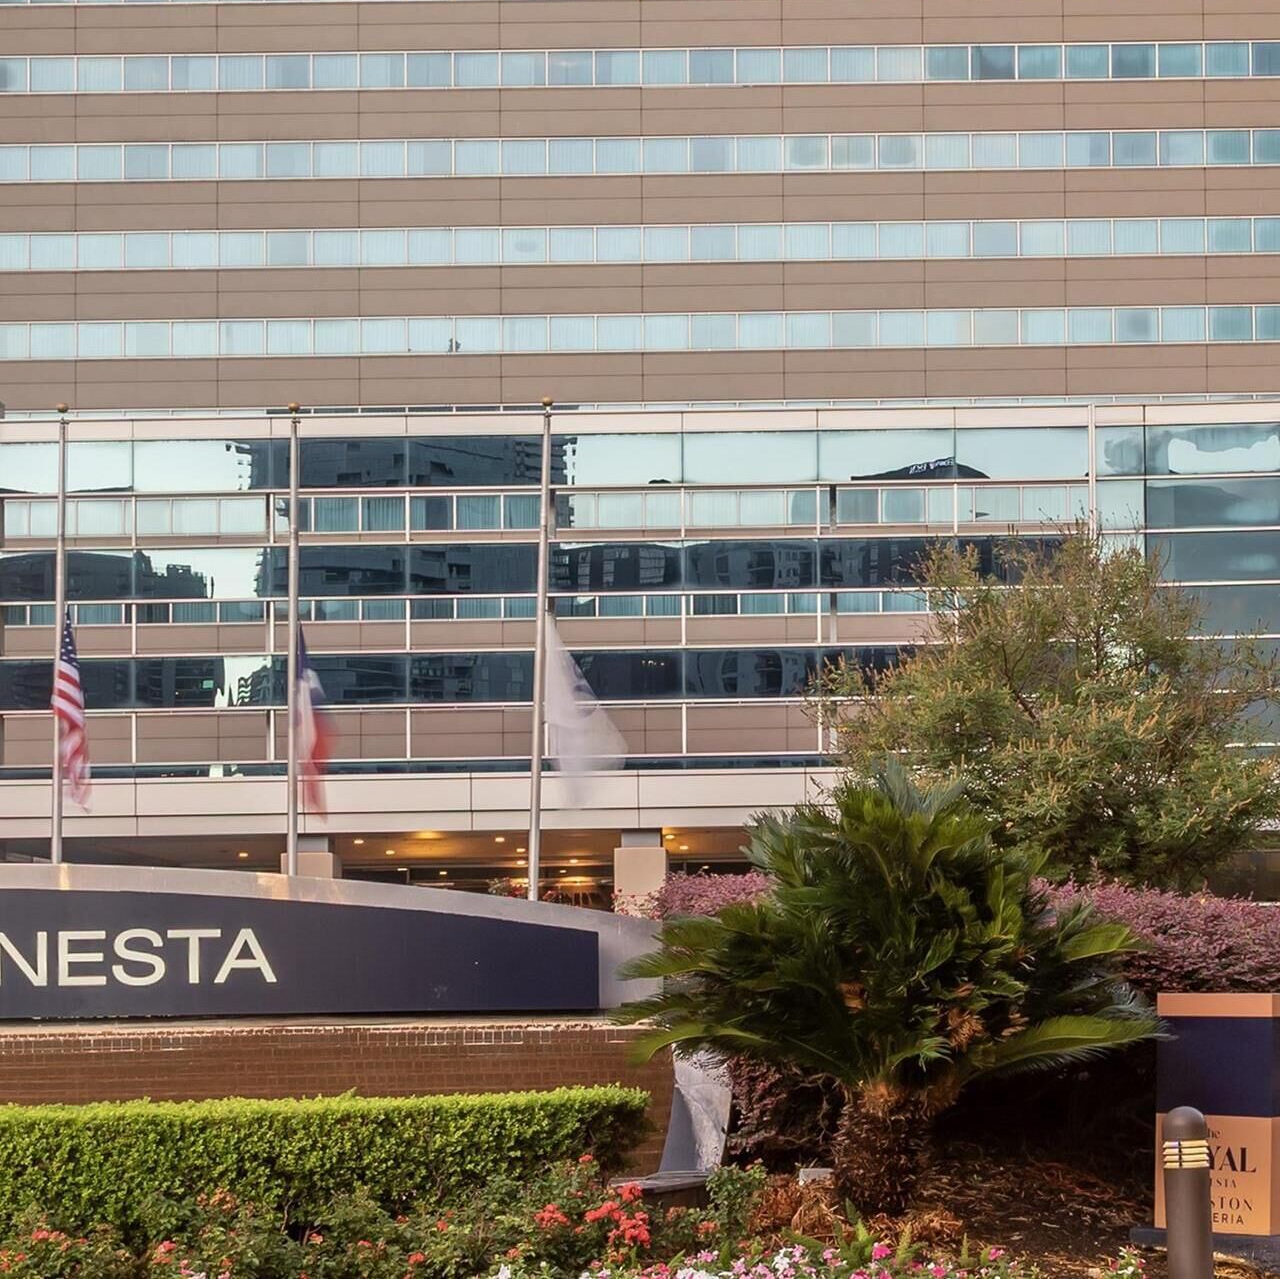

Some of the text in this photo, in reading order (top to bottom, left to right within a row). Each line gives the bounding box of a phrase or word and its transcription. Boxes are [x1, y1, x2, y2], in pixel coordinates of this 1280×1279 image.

[1207, 1128, 1221, 1139] he
[1207, 1145, 1257, 1173] YAL
[1212, 1212, 1245, 1225] ERIA
